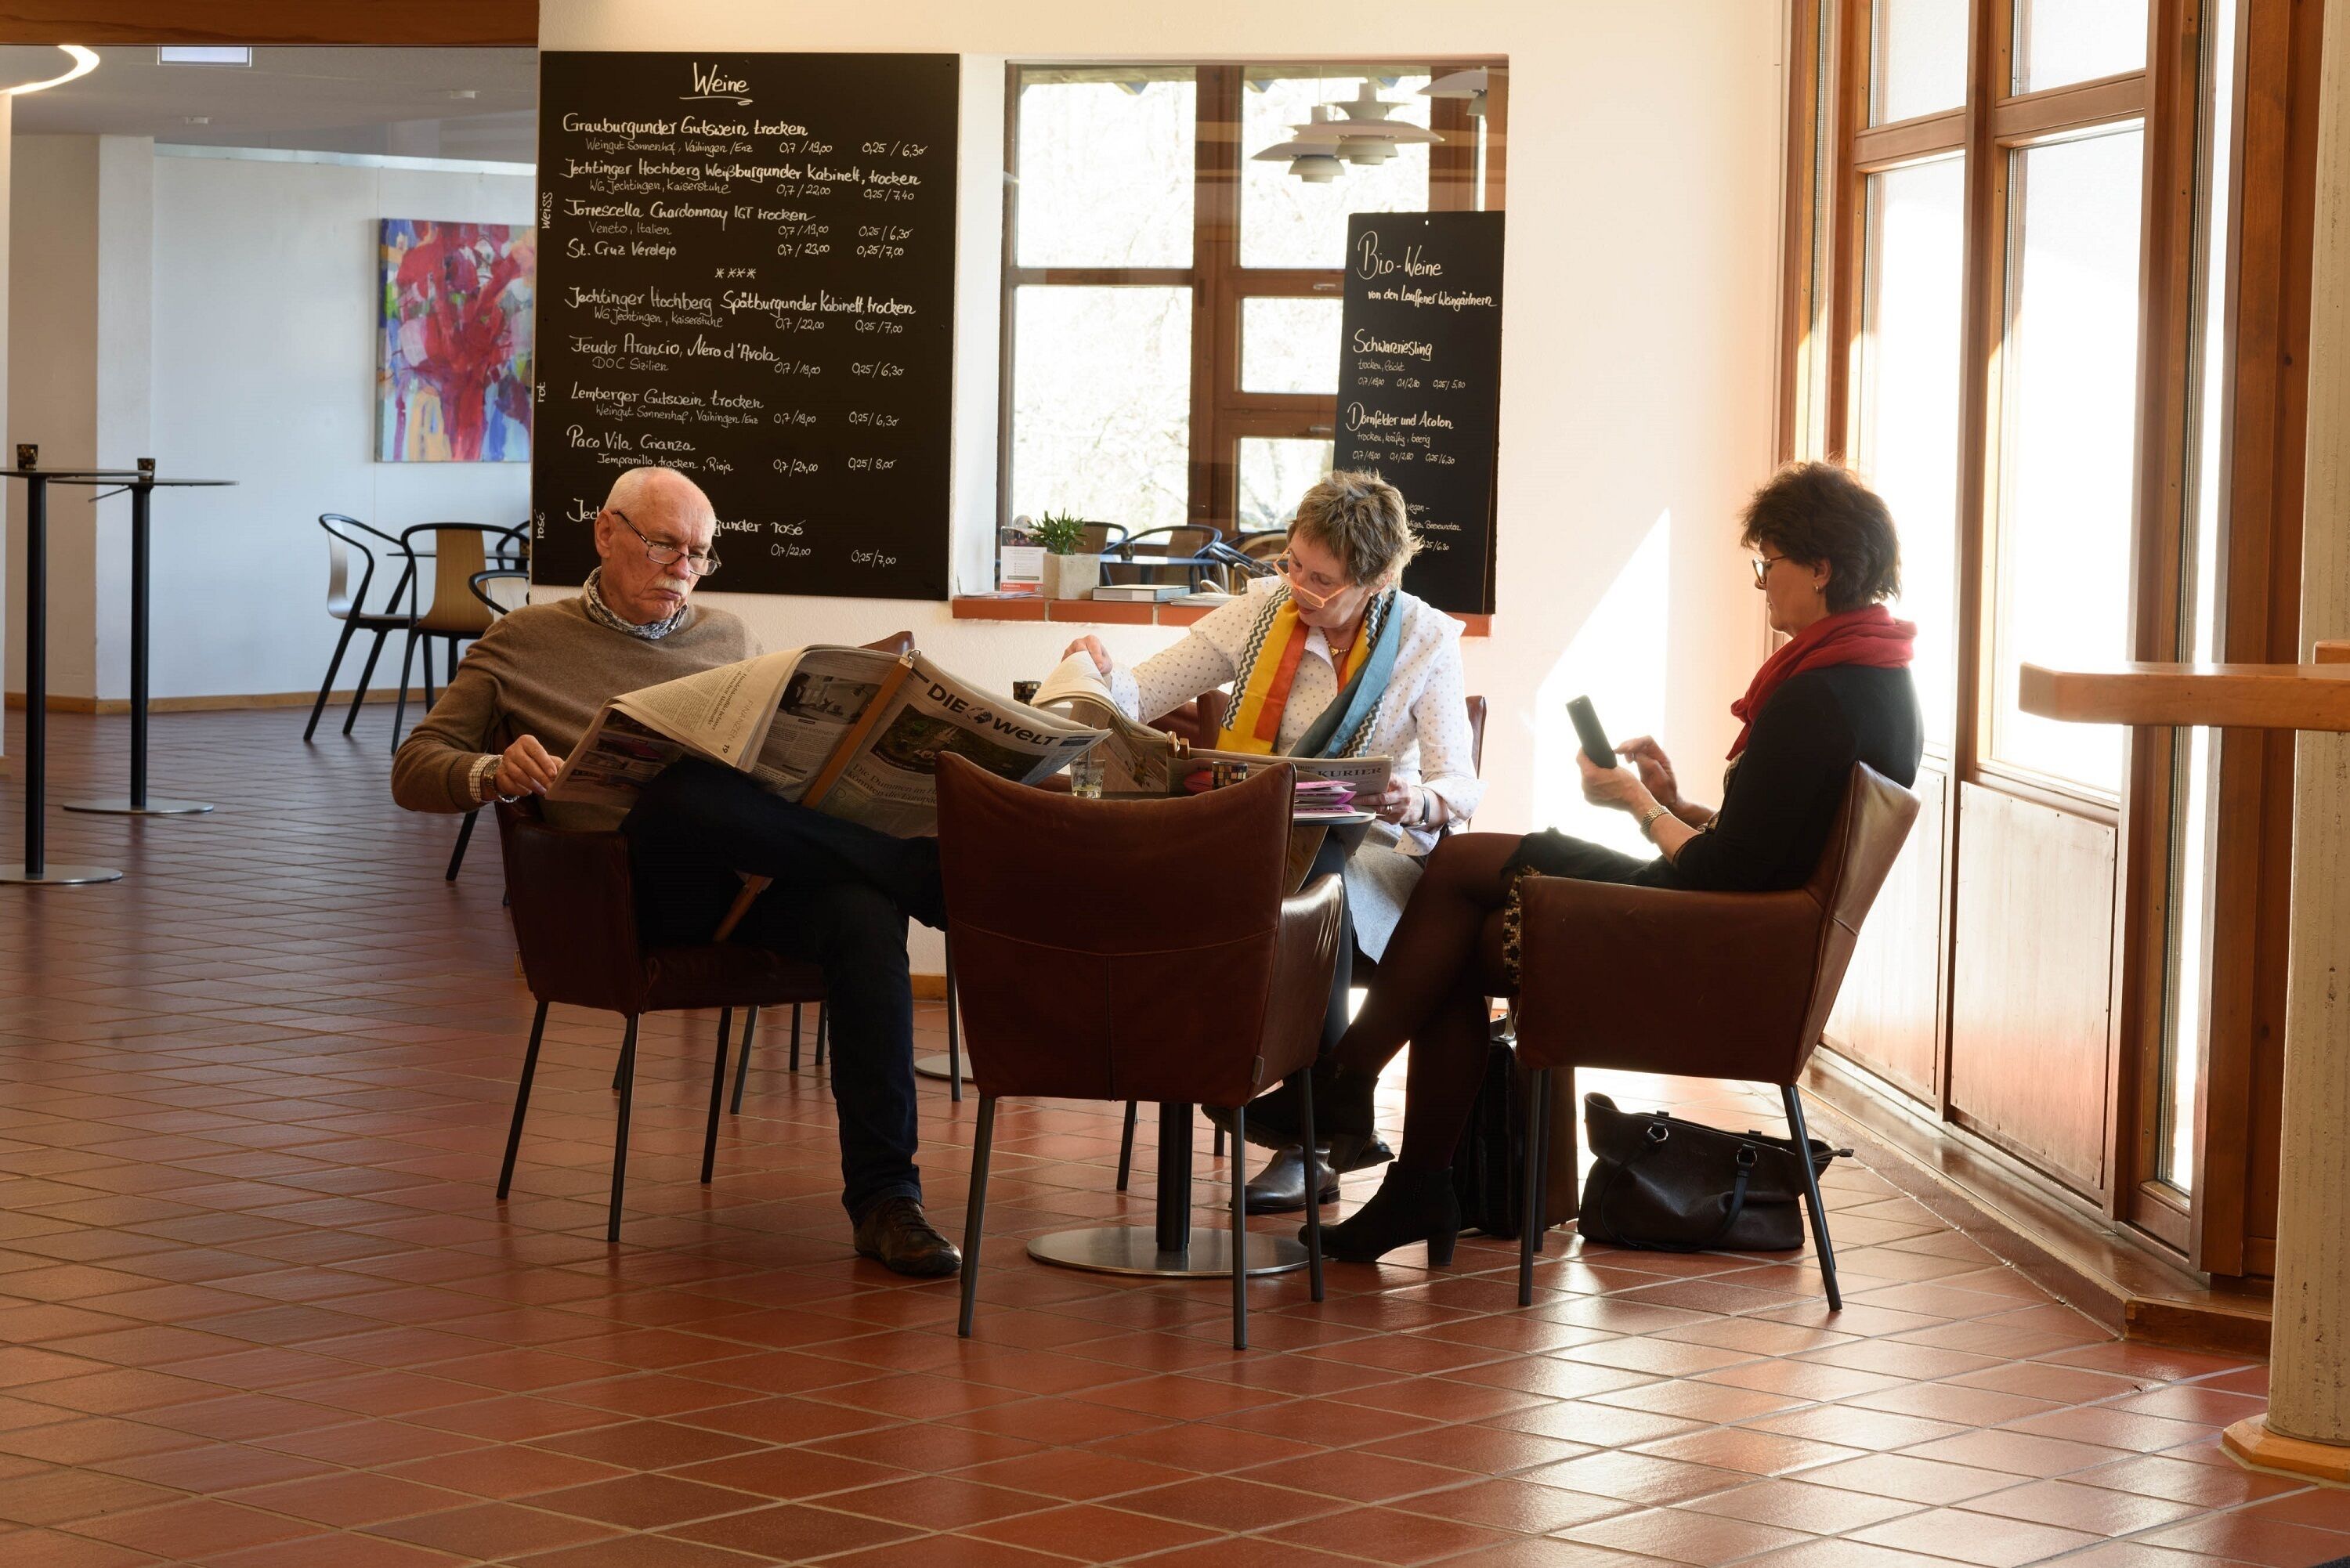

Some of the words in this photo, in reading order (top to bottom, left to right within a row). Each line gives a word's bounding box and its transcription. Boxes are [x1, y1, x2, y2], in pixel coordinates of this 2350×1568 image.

[693, 62, 750, 96] Weine
[563, 112, 678, 140] Grauburgunder
[680, 116, 749, 136] Gutswein
[754, 119, 808, 136] trocken
[585, 138, 624, 154] Weingut
[559, 157, 633, 180] Jechtinger
[638, 157, 700, 181] Hochberg
[705, 163, 802, 183] Weißburgunder
[870, 170, 921, 186] trocken
[589, 179, 605, 192] WG
[649, 201, 728, 231] Chardonnay
[734, 204, 754, 219] IGT
[757, 208, 816, 221] trocken
[637, 222, 672, 235] Italien
[566, 237, 591, 258] St.
[595, 240, 626, 256] Cruz
[631, 240, 677, 260] Verdejo
[564, 287, 645, 312] Jechtinger
[650, 286, 712, 316] Hochberg
[720, 290, 817, 318] Spätburgunder
[868, 295, 916, 316] trocken
[1368, 291, 1380, 300] von
[1383, 288, 1398, 301] den
[1401, 285, 1437, 308] Lauffener
[1438, 291, 1497, 312] Weingärtnern
[594, 305, 610, 320] WG
[687, 334, 721, 356] Nero
[592, 356, 626, 370] DOC
[629, 357, 669, 371] Sizilien
[571, 381, 639, 407] Lemberger
[644, 388, 705, 406] Gutswein
[710, 390, 764, 409] trocken
[596, 403, 634, 421] Weingut
[1346, 402, 1399, 431] Dornfelder
[1401, 414, 1416, 425] und
[1419, 410, 1454, 429] Acolon
[566, 425, 600, 448] Paco
[605, 432, 632, 450] Vila
[640, 434, 696, 451] Crianza
[706, 457, 733, 475] Rioja
[927, 682, 969, 714] DIE
[722, 744, 730, 753] 19
